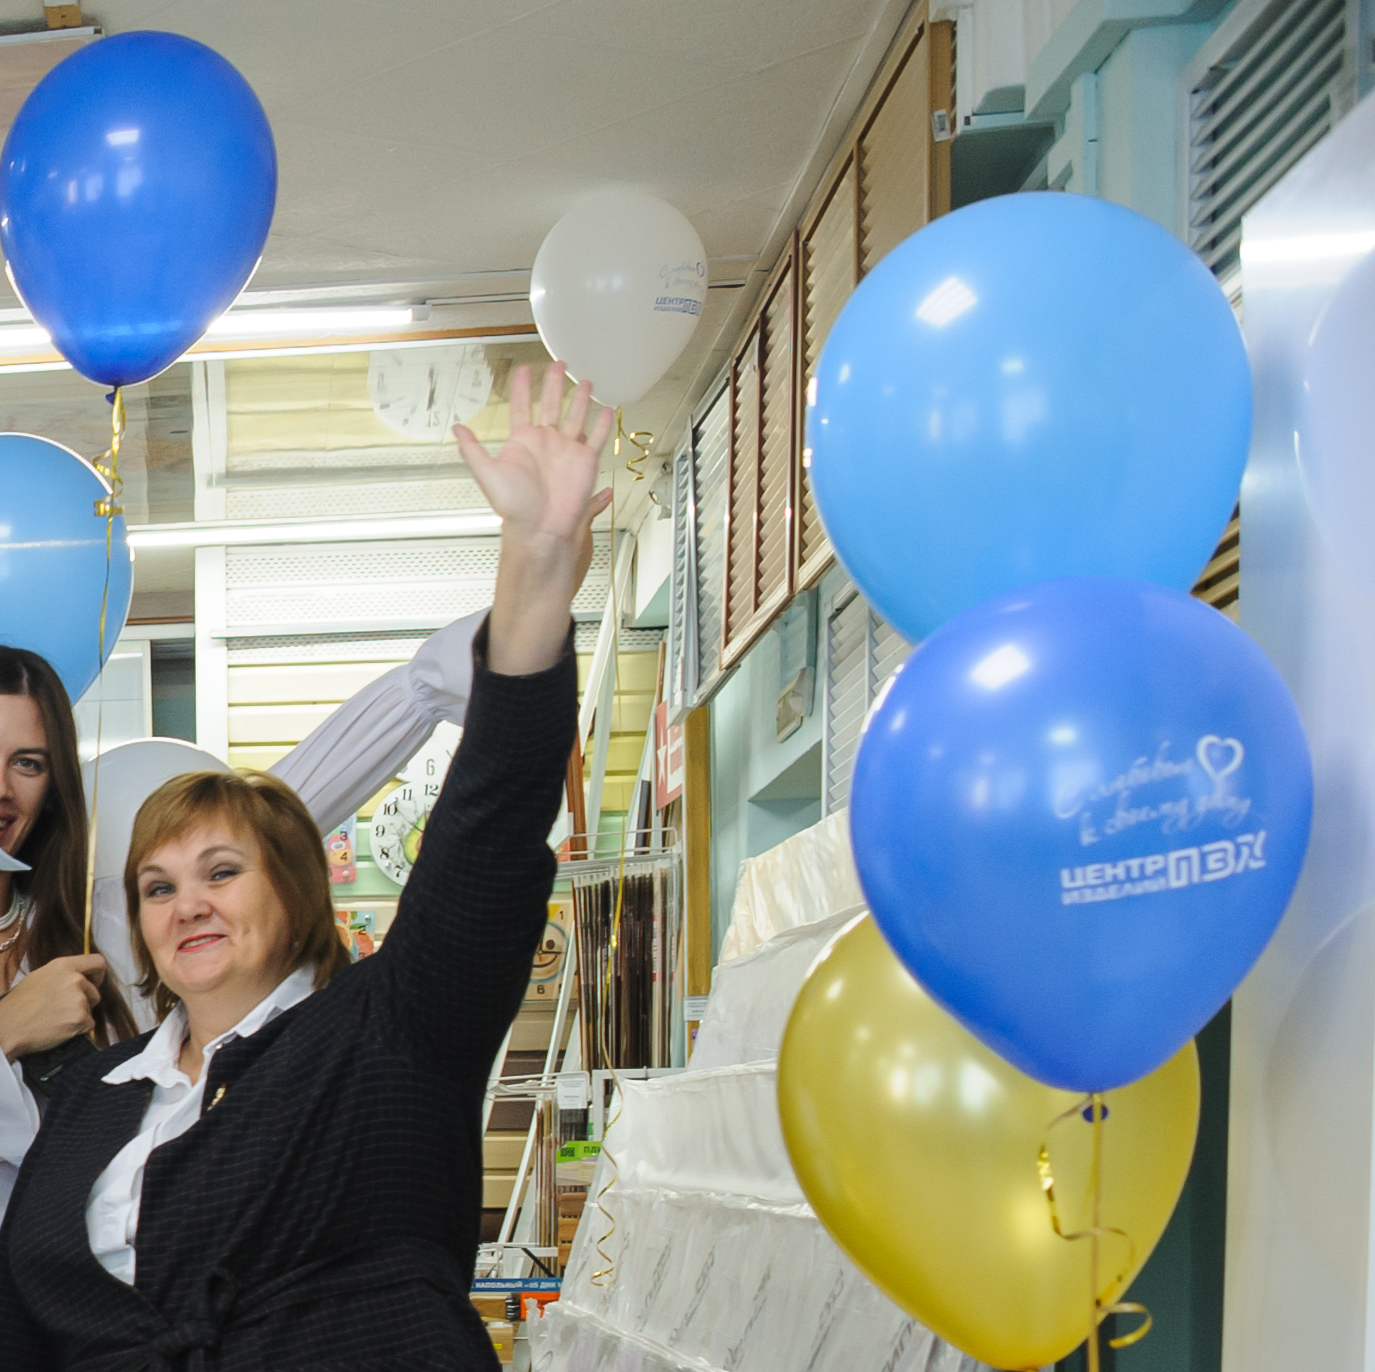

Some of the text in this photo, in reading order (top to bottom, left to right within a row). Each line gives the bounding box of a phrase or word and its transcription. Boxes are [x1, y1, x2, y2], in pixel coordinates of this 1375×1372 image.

[426, 758, 435, 776] 6
[401, 788, 414, 801] 11
[423, 783, 439, 797] 12
[382, 802, 398, 817] 10
[339, 830, 348, 841] 3
[375, 824, 386, 838] 9
[339, 851, 348, 861] 4
[379, 846, 391, 861] 8
[394, 863, 404, 878] 7
[1060, 853, 1166, 889] ЦЕНТР
[1061, 876, 1170, 906] ИЗДЕЛИЙ
[559, 910, 564, 920] 1
